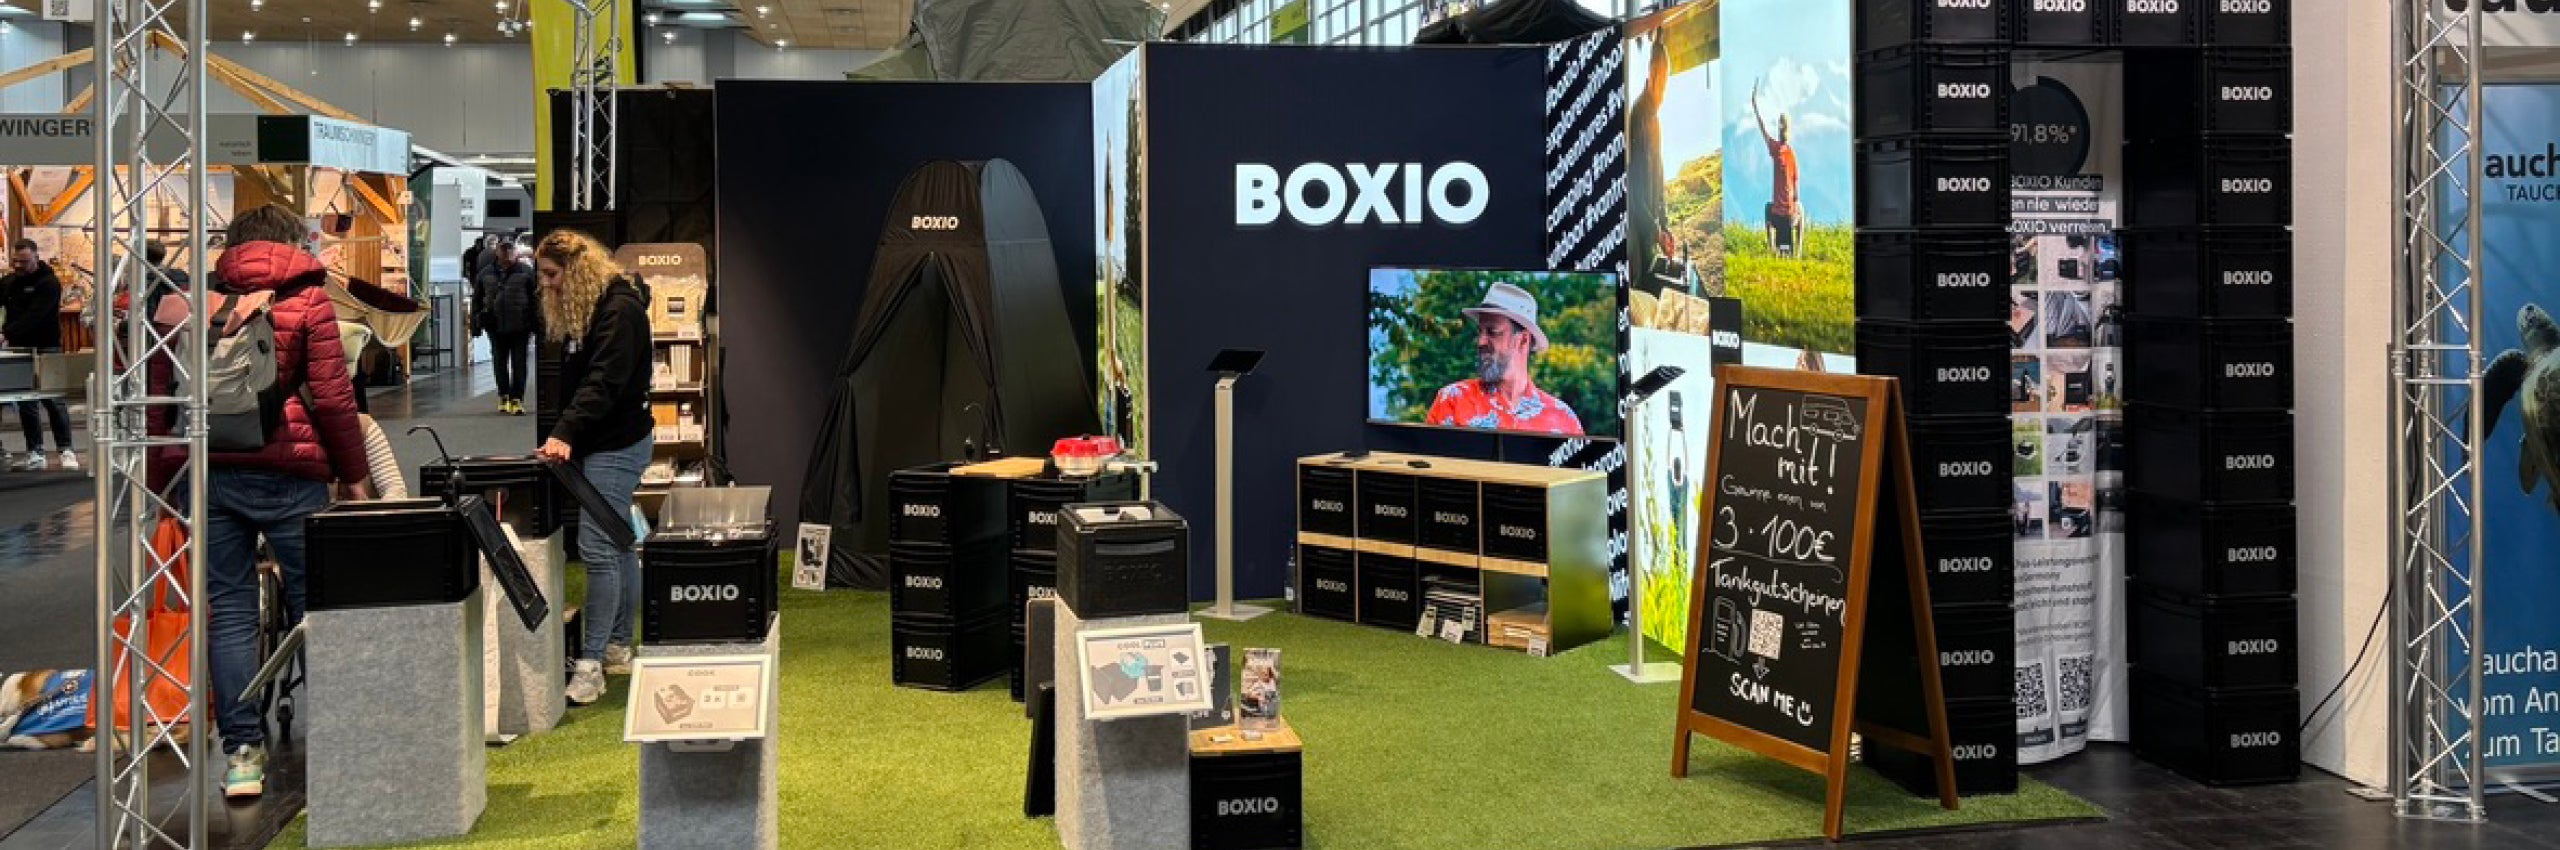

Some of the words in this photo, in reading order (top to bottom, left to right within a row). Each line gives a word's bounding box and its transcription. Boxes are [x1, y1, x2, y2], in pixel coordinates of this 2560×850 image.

[2033, 0, 2086, 12] BOXIO
[2126, 0, 2179, 14] BOXIO
[2219, 0, 2271, 14] BOXIO
[1937, 82, 1991, 99] BOXIO
[2221, 86, 2273, 101] BOXIO
[1937, 177, 1991, 192] BOXIO
[2012, 175, 2051, 188] OXIO
[2221, 177, 2273, 194] BOXIO
[1235, 161, 1490, 226] BOXIO
[2506, 183, 2560, 202] TAUC
[911, 215, 959, 231] BOXIO
[2011, 220, 2046, 233] OXIO
[638, 254, 682, 266] BOXIO
[1937, 272, 1991, 287] BOXIO
[2223, 270, 2273, 285] BOXIO
[1937, 365, 1991, 383] BOXIO
[2225, 361, 2275, 378] BOXIO
[1729, 388, 1803, 454] Mach
[1777, 436, 1836, 496] mit!
[1939, 460, 1993, 478] BOXIO
[2225, 454, 2275, 469] BOXIO
[904, 504, 941, 517] BOXIO
[1312, 498, 1344, 513] BOXIO
[1374, 504, 1408, 519] BOXIO
[1028, 510, 1058, 525] BOXI
[1435, 510, 1469, 526] BOXIO
[1500, 524, 1537, 540] BOXIO
[1713, 504, 1740, 551] 3
[1761, 513, 1837, 562] 100€
[2227, 545, 2277, 562] BOXIO
[1939, 556, 1993, 573] BOXIO
[904, 575, 943, 590] BOXIO
[1316, 578, 1348, 593] BOXIO
[670, 584, 740, 602] BOXIO
[1374, 586, 1409, 602] BOXIO
[906, 645, 943, 662] BOXIO
[2228, 638, 2278, 655] BOXIO
[1940, 649, 1995, 666] BOXIO
[1729, 671, 1772, 706] SCAN
[1774, 690, 1796, 718] ME
[2230, 731, 2281, 749] BOXIO
[2529, 727, 2560, 755] Ta
[1952, 743, 1998, 761] OXIO
[1218, 796, 1279, 816] BOXIO
